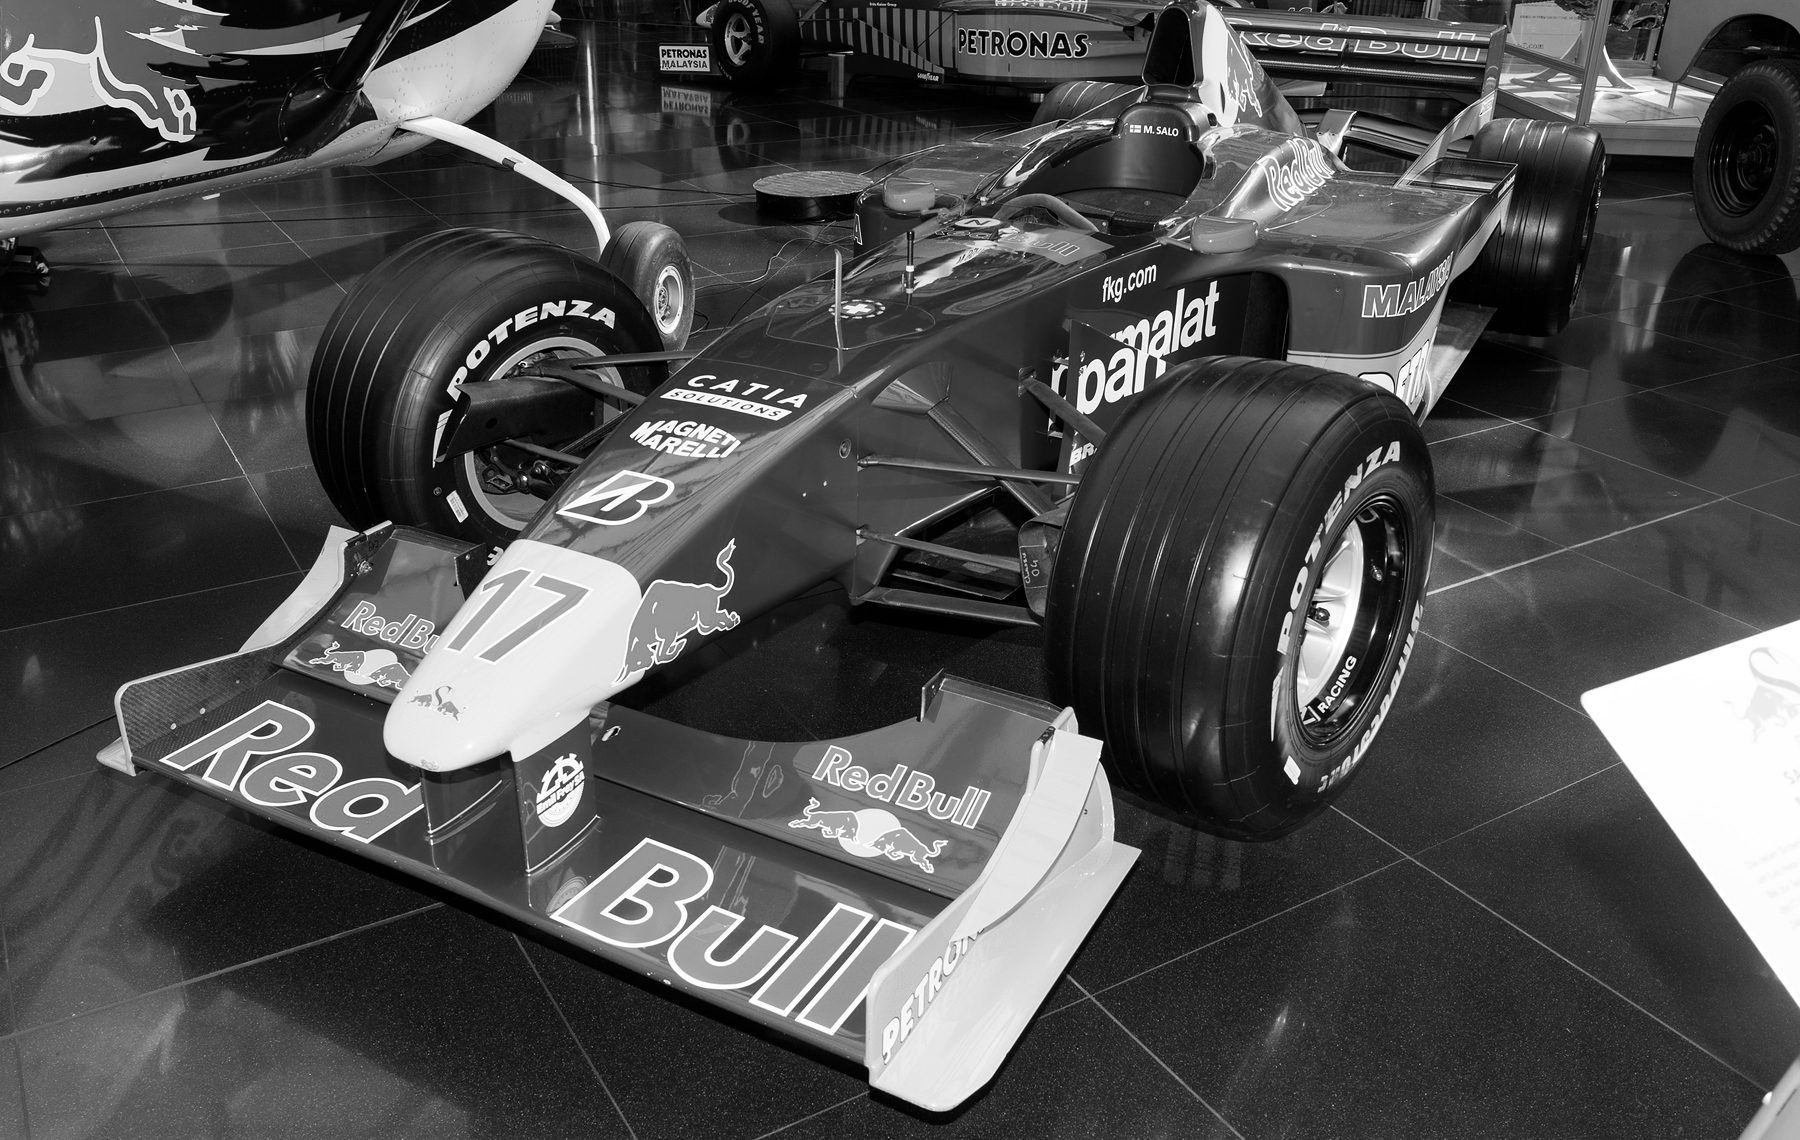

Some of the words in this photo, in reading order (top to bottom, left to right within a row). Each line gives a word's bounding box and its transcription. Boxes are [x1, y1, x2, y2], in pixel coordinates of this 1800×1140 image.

[661, 48, 707, 59] PETRONAS
[958, 28, 1089, 58] PETRONAS
[661, 59, 708, 70] MALAYSIA
[1143, 125, 1155, 135] M.
[1156, 125, 1179, 137] SALO
[1102, 264, 1157, 303] fkg.com
[446, 300, 616, 401] POTENZA
[668, 389, 785, 420] SOLUTIONS
[686, 374, 809, 409] CATIA
[630, 420, 741, 454] MAGNETI
[630, 430, 741, 458] MARELLI
[1276, 440, 1401, 657] POTENZA
[444, 567, 594, 665] 17
[1317, 654, 1358, 714] RACING
[159, 700, 427, 844] Red
[550, 837, 918, 1035] Bull
